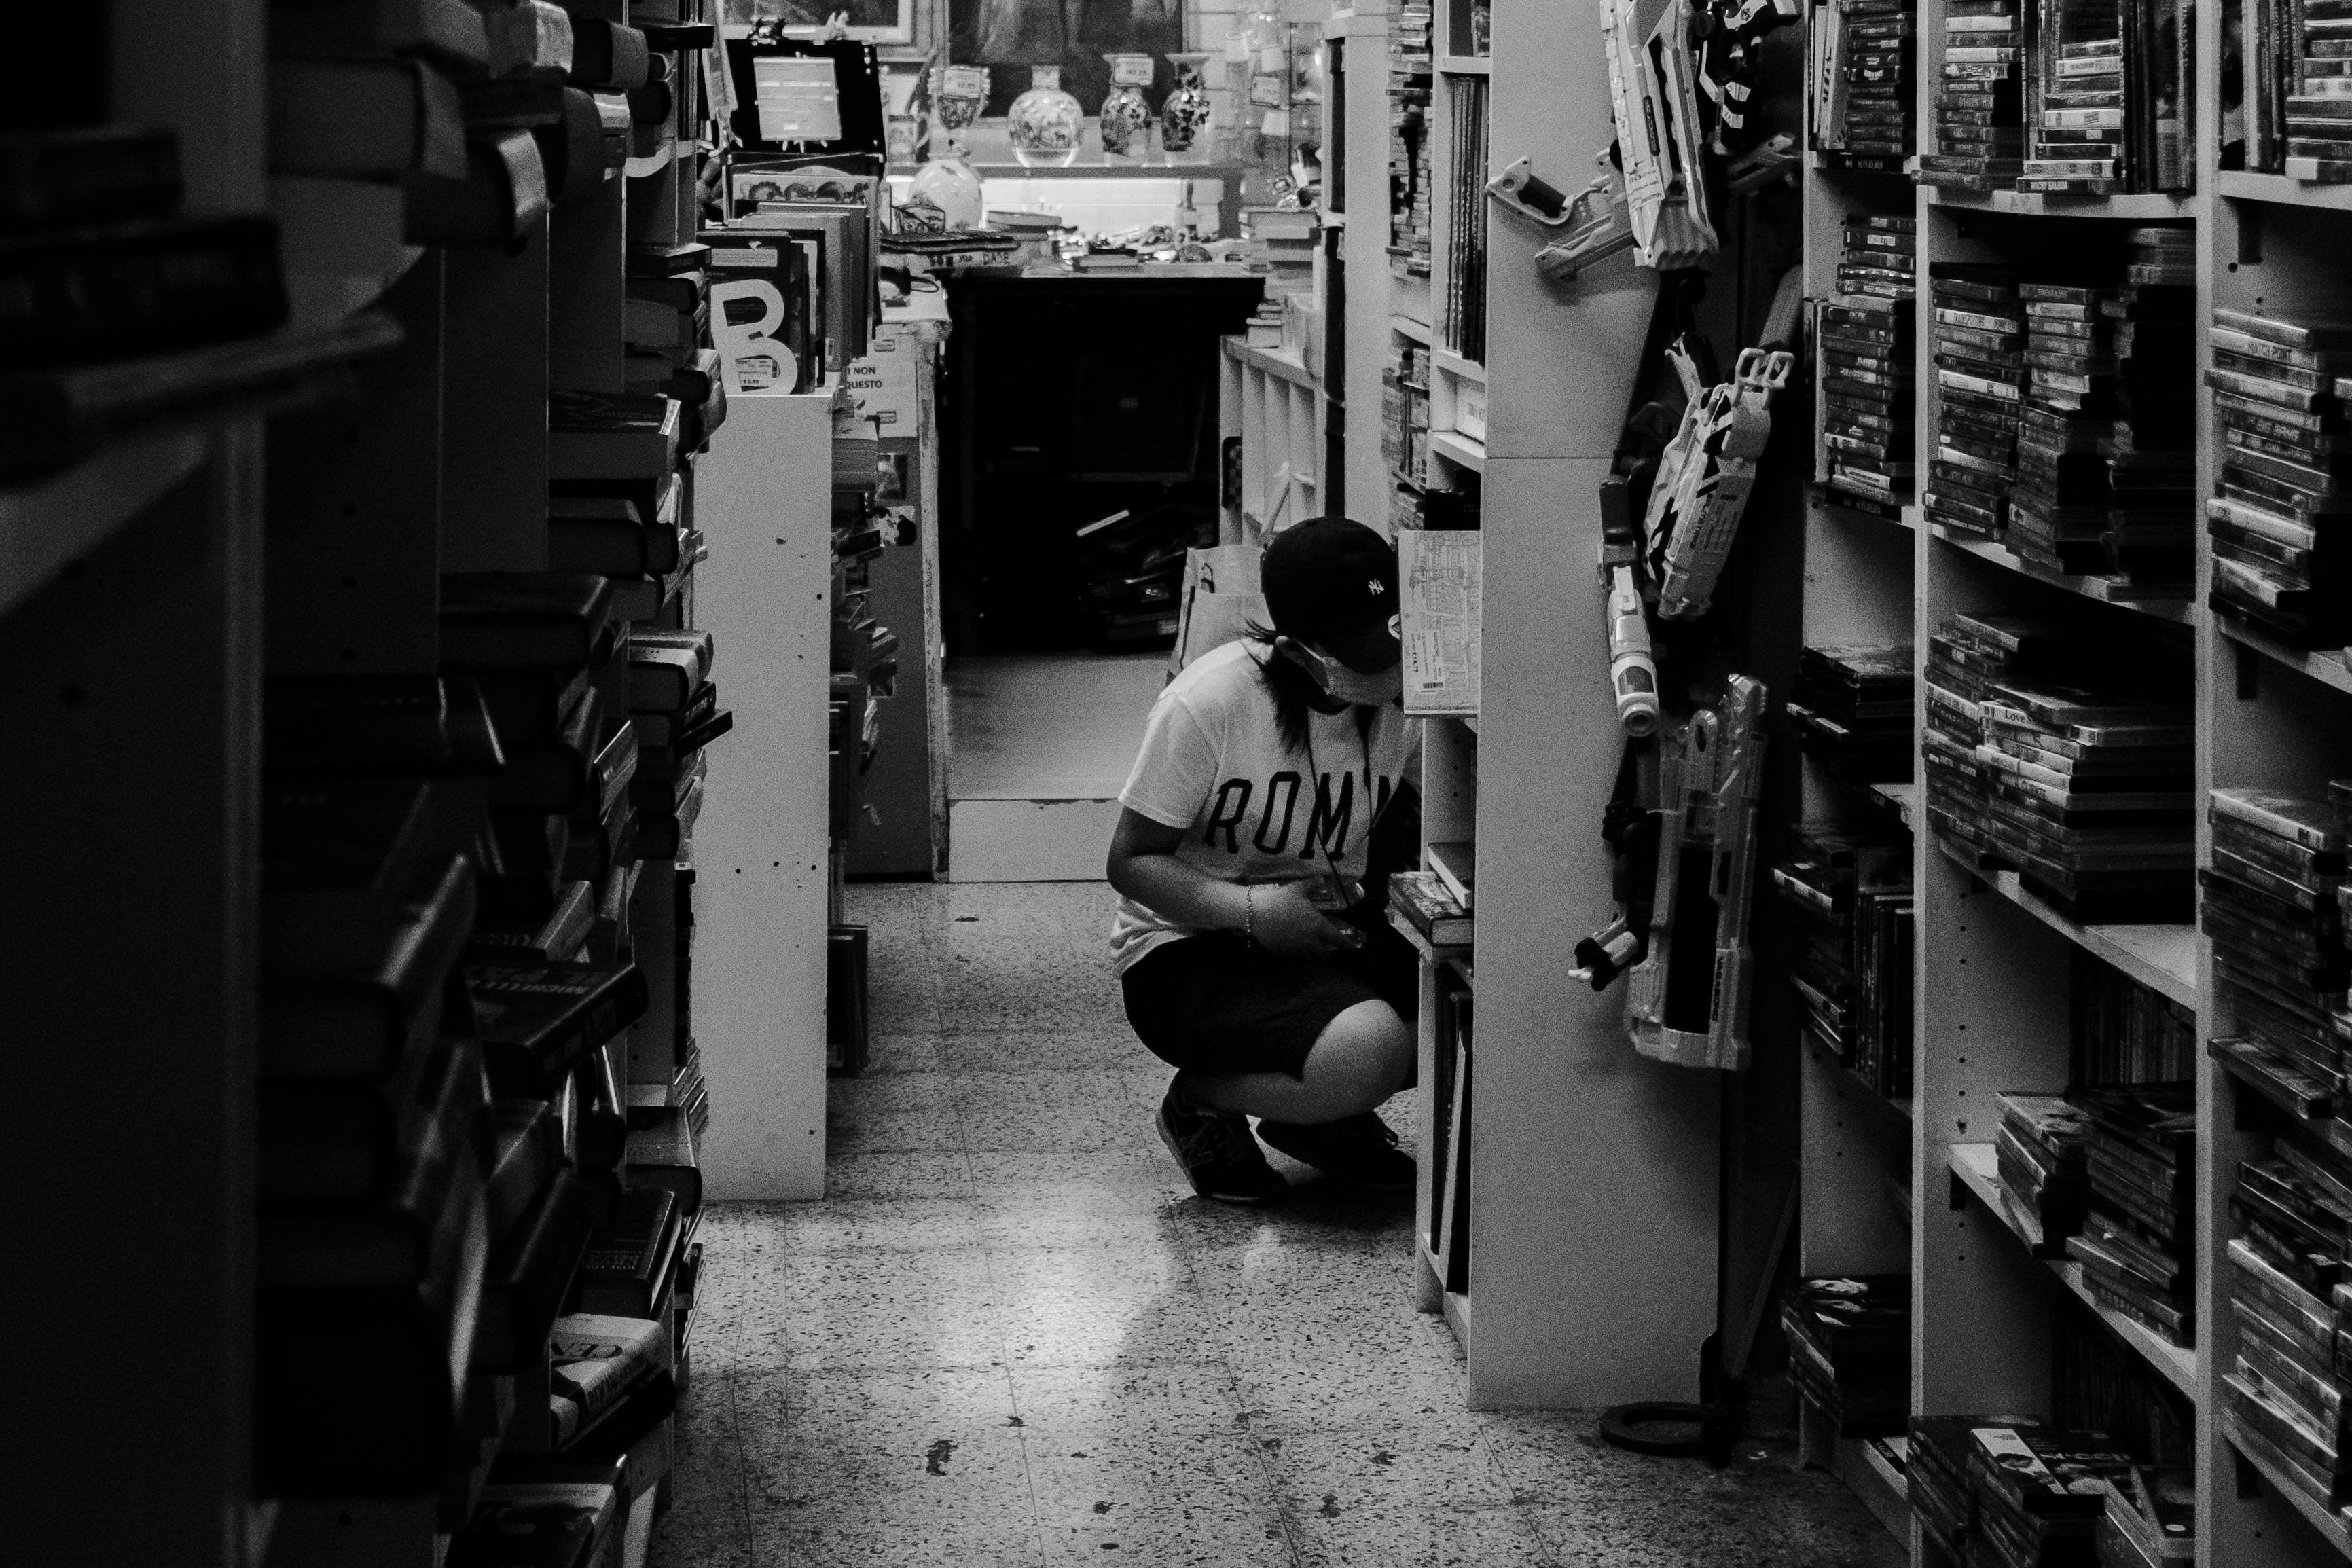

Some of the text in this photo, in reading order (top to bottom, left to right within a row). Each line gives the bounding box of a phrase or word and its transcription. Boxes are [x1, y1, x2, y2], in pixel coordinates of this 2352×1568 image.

[710, 278, 799, 395] B
[853, 367, 876, 376] NON
[846, 380, 883, 390] QUESTO
[1368, 578, 1385, 596] NY
[2003, 709, 2026, 724] Love
[1712, 955, 1724, 1021] VAGABOND
